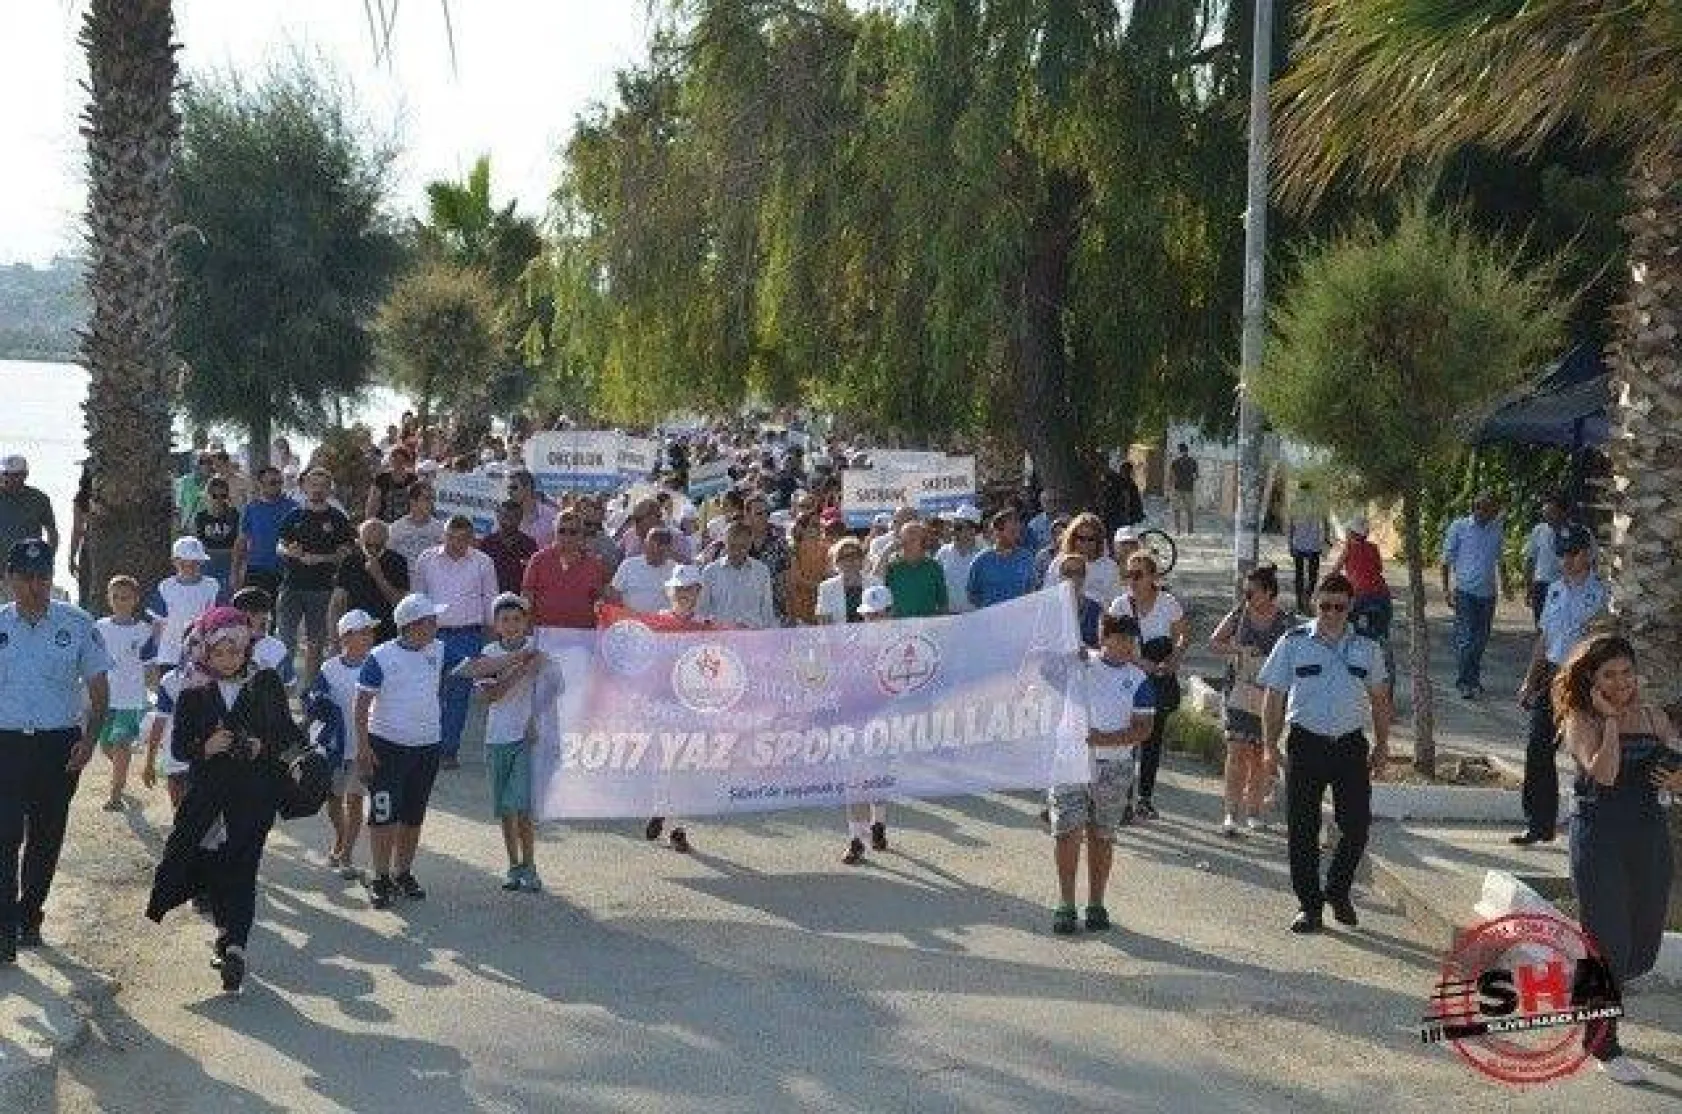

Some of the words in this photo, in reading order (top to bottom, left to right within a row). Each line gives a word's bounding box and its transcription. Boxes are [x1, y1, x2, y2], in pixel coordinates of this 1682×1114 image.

[561, 730, 653, 771] 2017
[659, 730, 740, 771] YAZ
[753, 724, 856, 768] SPOR
[863, 697, 1053, 756] OKULLARI
[374, 790, 390, 823] 9
